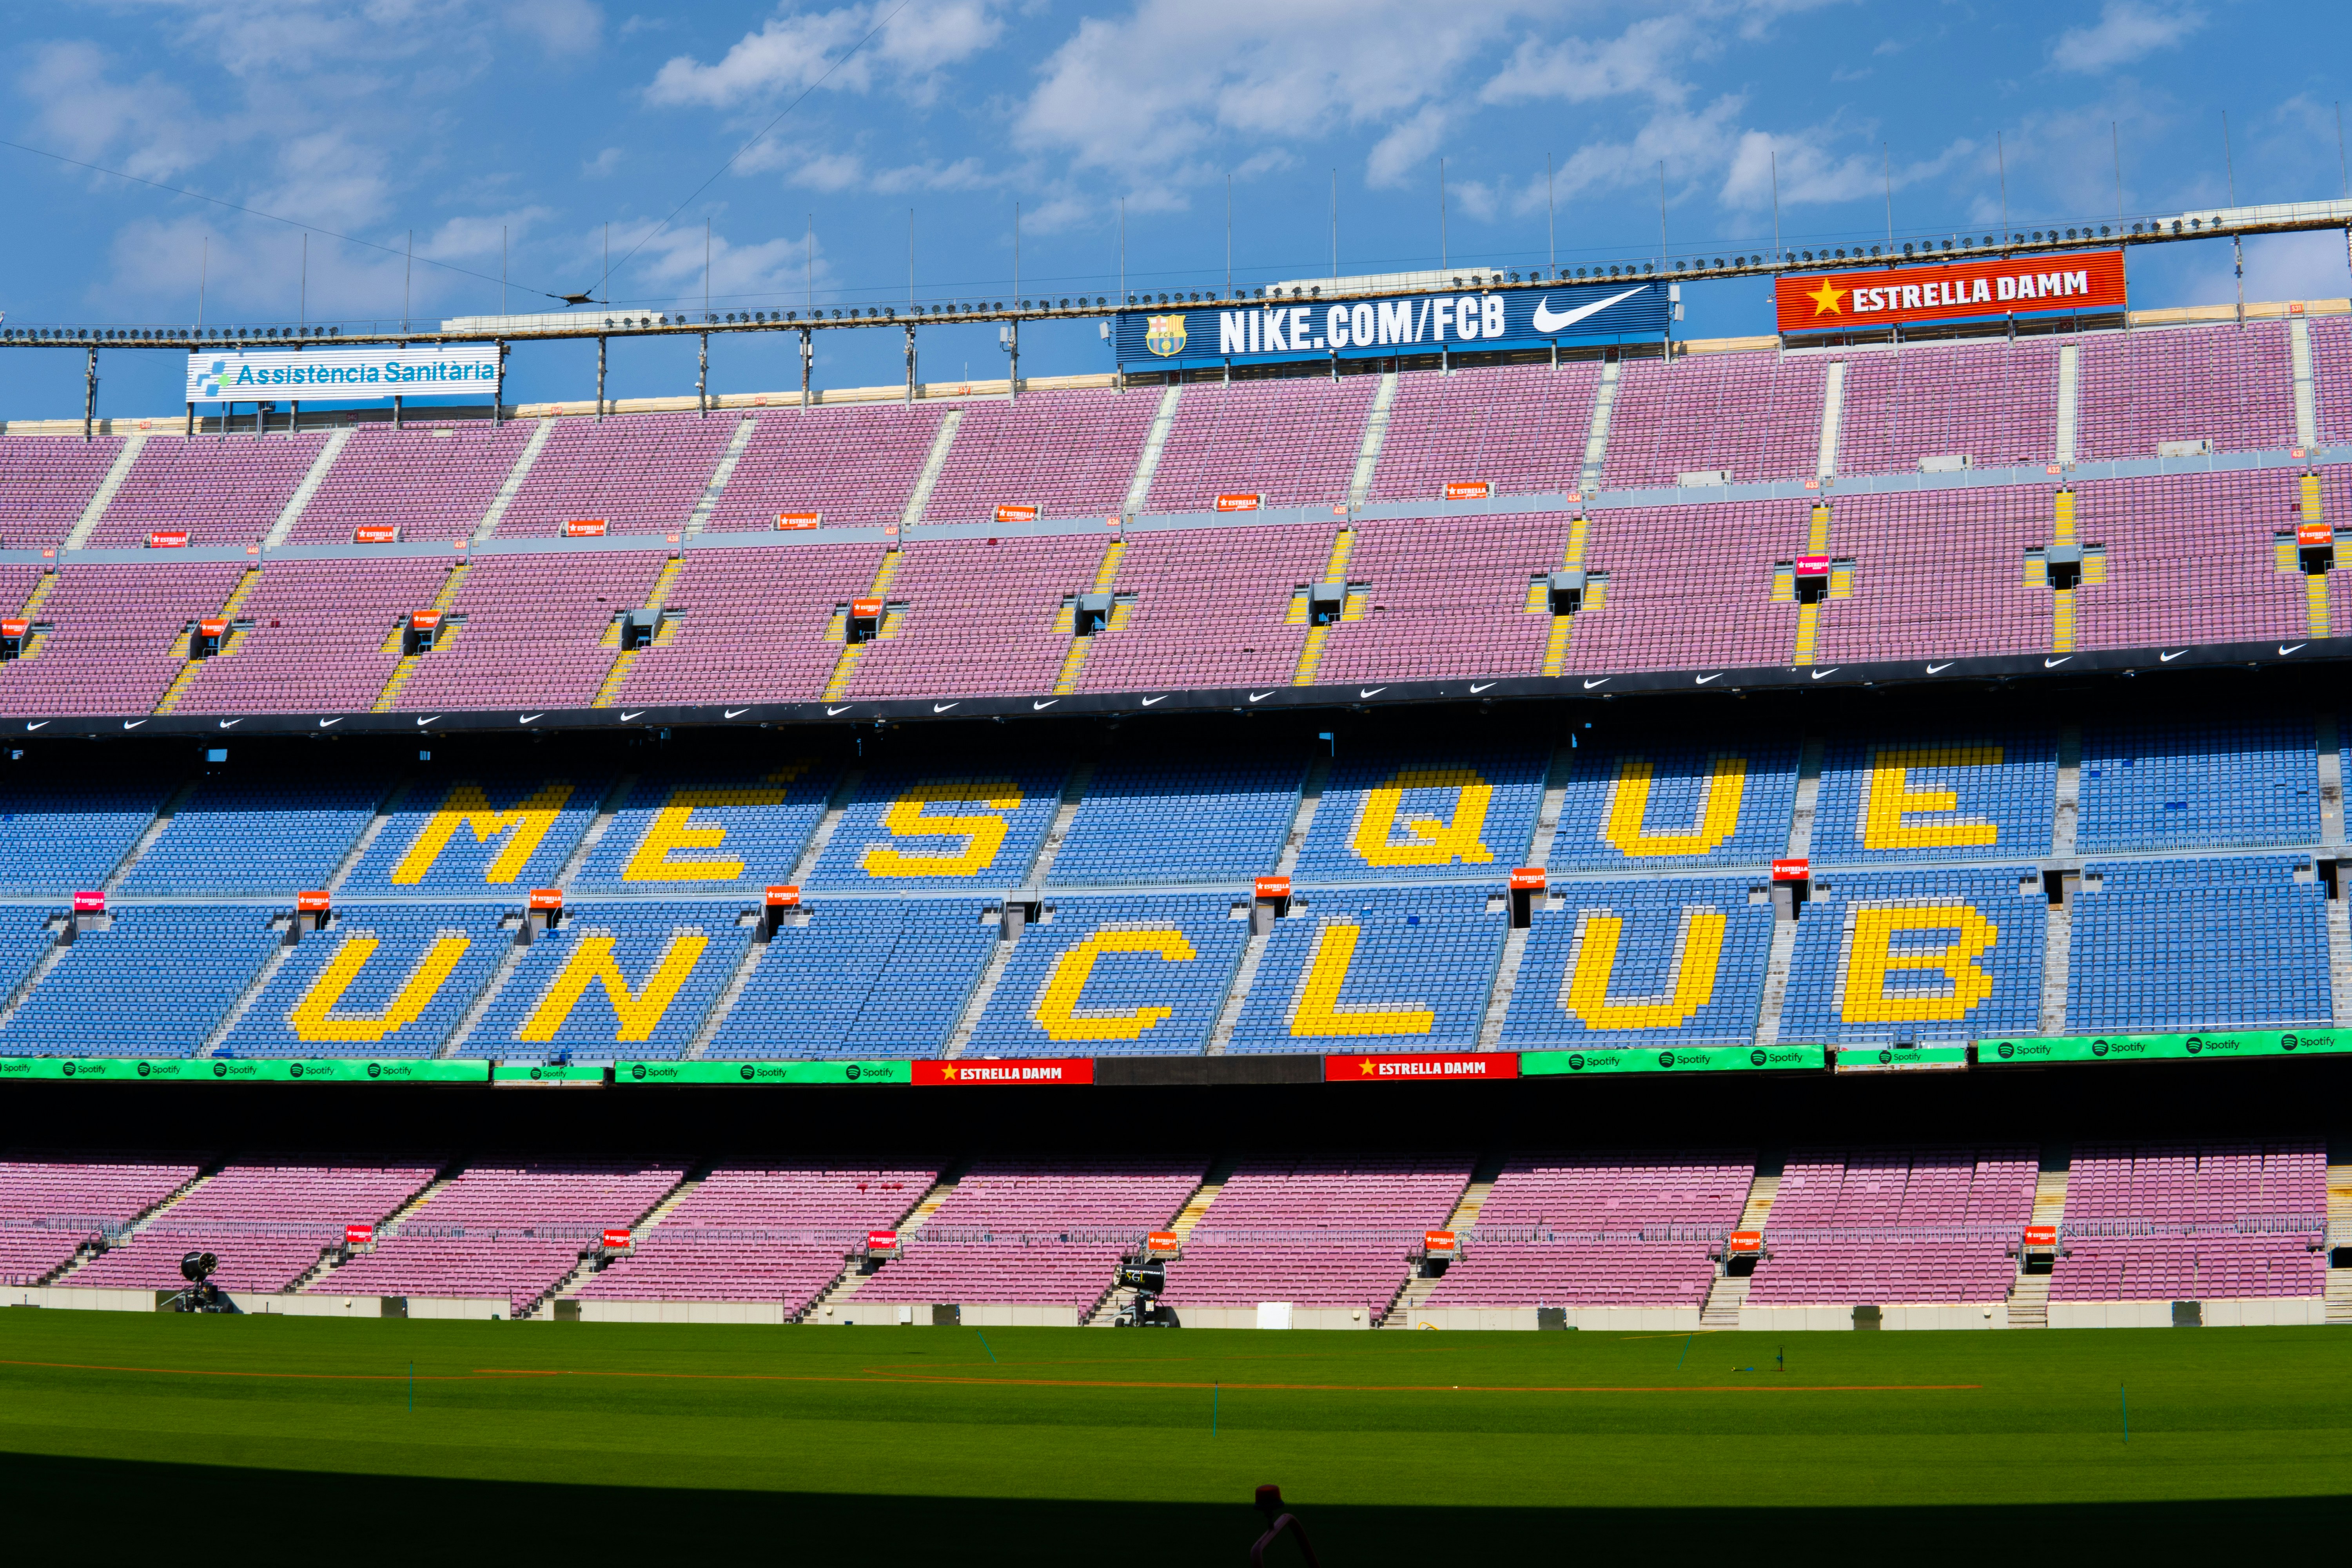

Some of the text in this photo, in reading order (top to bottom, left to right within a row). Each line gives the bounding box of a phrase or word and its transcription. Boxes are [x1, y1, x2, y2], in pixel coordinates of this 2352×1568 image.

[1853, 270, 2089, 312] ESTRELLA DAMM
[1220, 295, 1505, 354] NIKE.COM/FCB
[237, 360, 494, 385] Assistència Sanitària
[1352, 746, 2004, 867] QUE
[290, 906, 1998, 1042] UN CLUB
[2206, 1040, 2239, 1051] Spotify
[2301, 1036, 2335, 1047] Spotify
[2017, 1045, 2051, 1056] Spotify
[2112, 1042, 2145, 1053] Spotify
[1588, 1056, 1620, 1067] Spotify
[1677, 1055, 1710, 1065] Spotify
[1769, 1053, 1802, 1063] Spotify
[1894, 1053, 1921, 1061] Spotify
[4, 1064, 30, 1073] Spotify
[78, 1065, 105, 1074] Spotify
[153, 1065, 180, 1074] Spotify
[229, 1066, 256, 1075] Spotify
[306, 1067, 334, 1075] Spotify
[383, 1067, 412, 1076] Spotify
[649, 1068, 678, 1077] Spotify
[757, 1068, 786, 1078] Spotify
[864, 1068, 893, 1077] Spotify
[1379, 1062, 1486, 1075] ESTRELLA DAMM
[960, 1068, 1062, 1080] ESTRELLA DAMM
[1126, 1272, 1145, 1282] SGL
